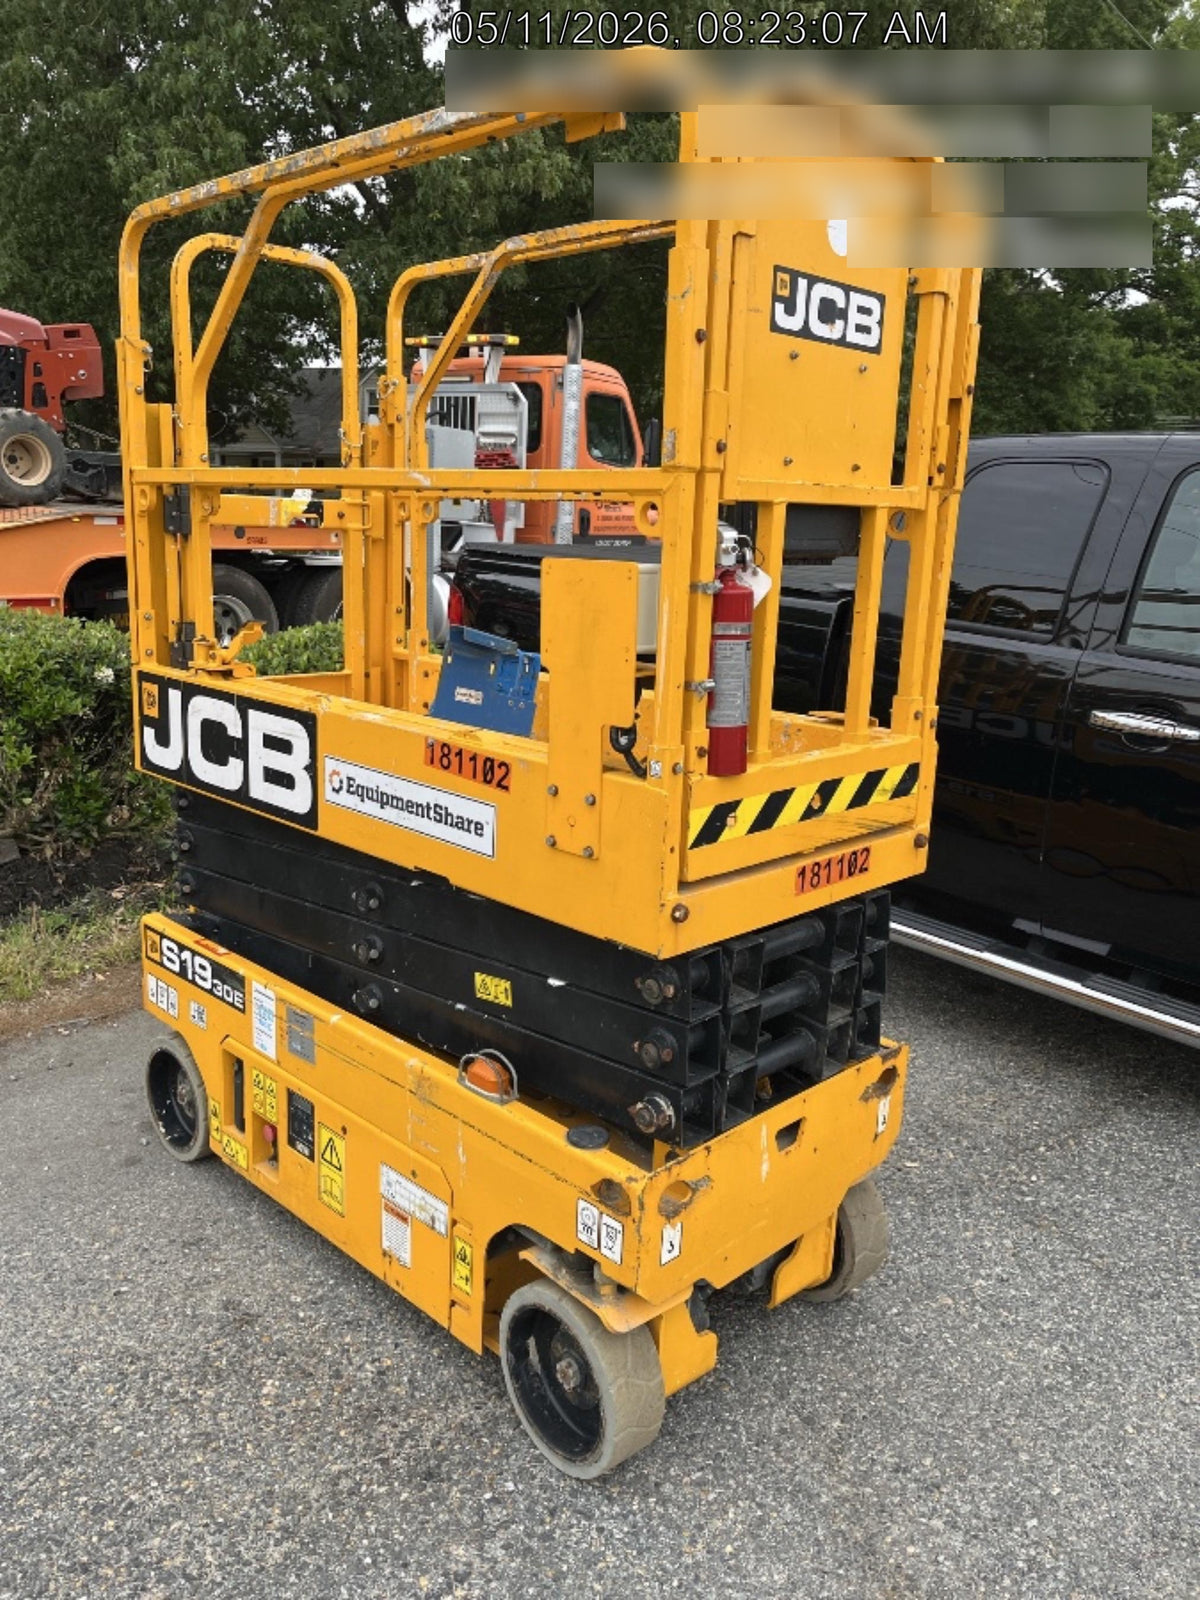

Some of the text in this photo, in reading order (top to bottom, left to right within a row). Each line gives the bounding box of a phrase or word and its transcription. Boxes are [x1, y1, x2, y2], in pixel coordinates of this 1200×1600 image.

[775, 277, 881, 348] JCB
[143, 688, 313, 815] JCB
[426, 738, 510, 791] 181102
[345, 776, 485, 838] EquipmentShare
[797, 847, 870, 893] 181102
